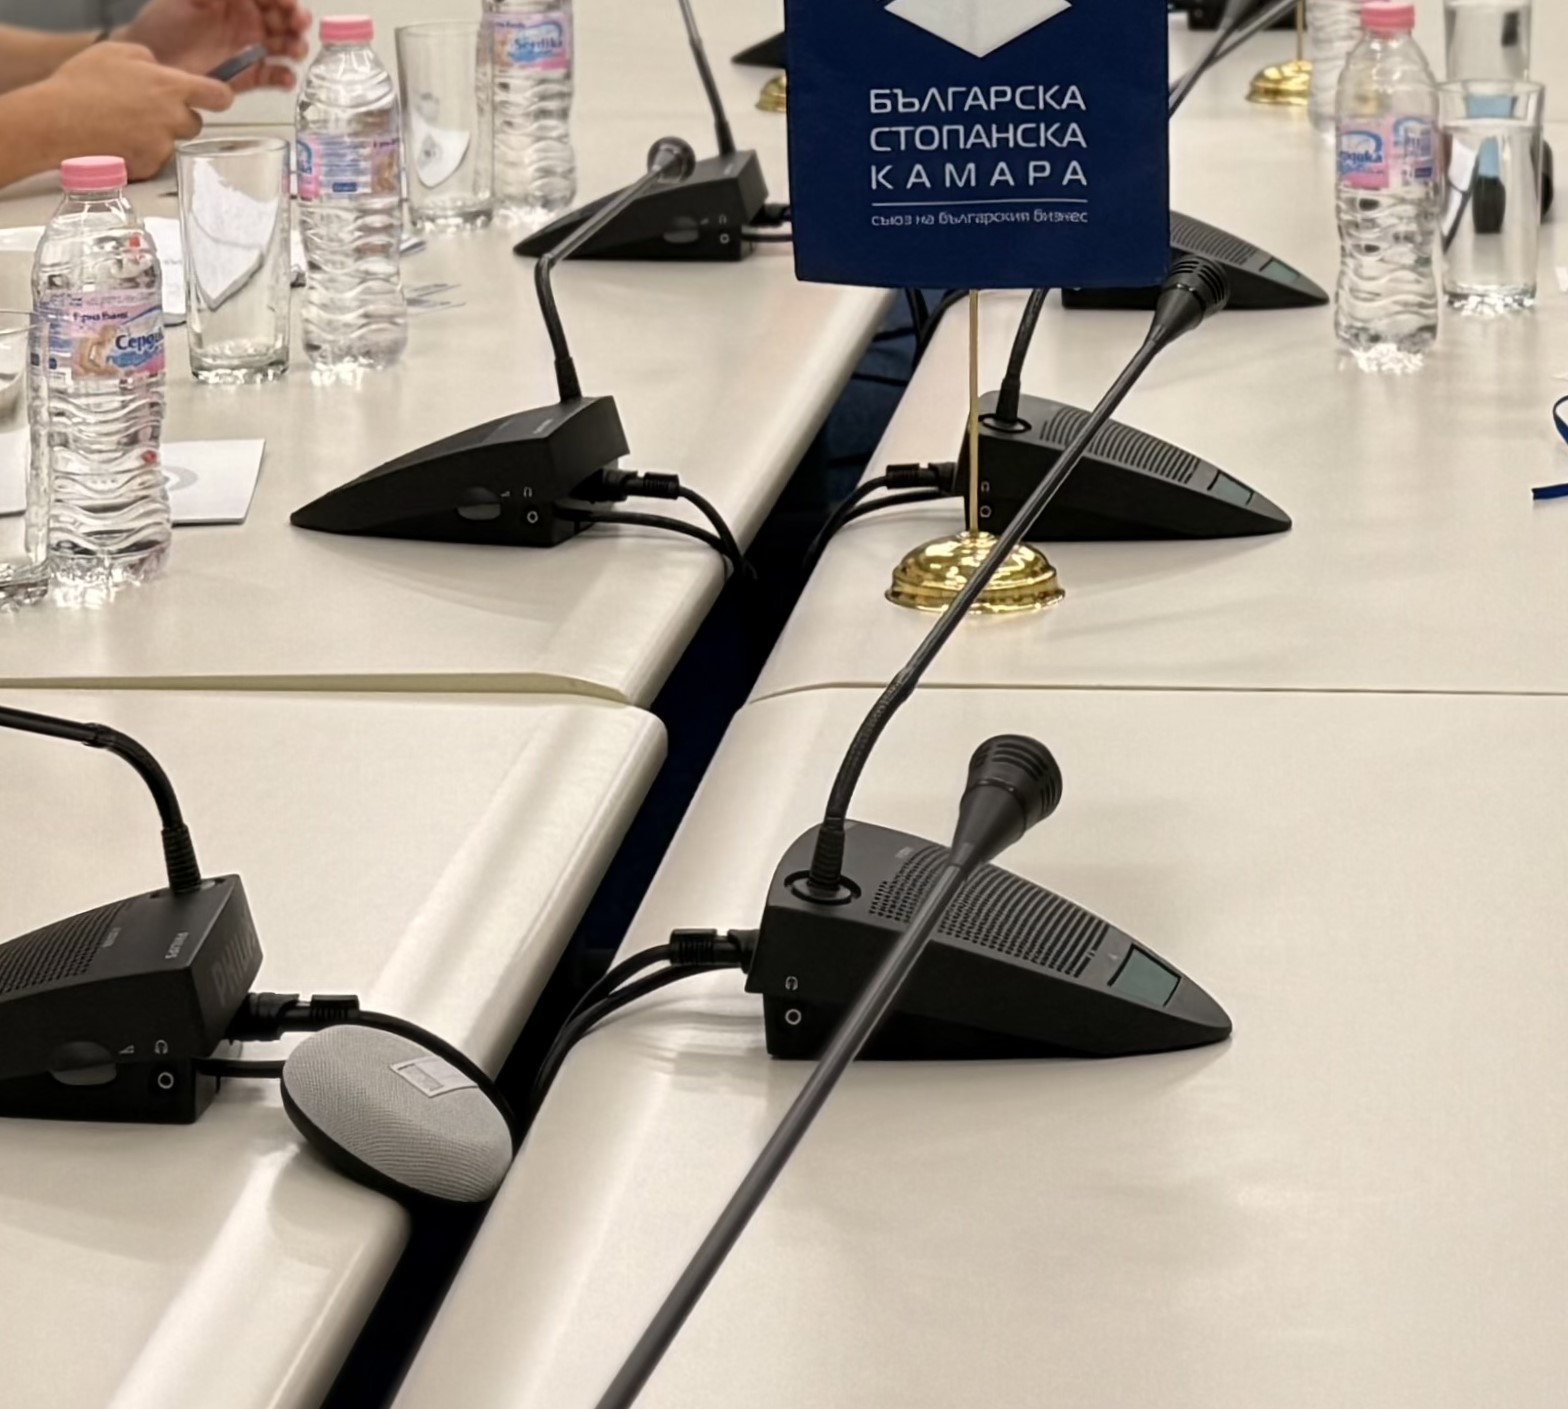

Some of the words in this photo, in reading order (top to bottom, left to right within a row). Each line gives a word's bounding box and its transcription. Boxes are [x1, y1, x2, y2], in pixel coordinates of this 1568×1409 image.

[869, 85, 1087, 114] БЪЛГАРСКА
[869, 122, 1088, 152] СТОПАНСКА
[870, 160, 1088, 190] КАМАРА
[871, 215, 913, 226] съюз
[915, 214, 935, 225] на
[1033, 208, 1088, 224] бизнес
[211, 928, 254, 1008] PHIL
